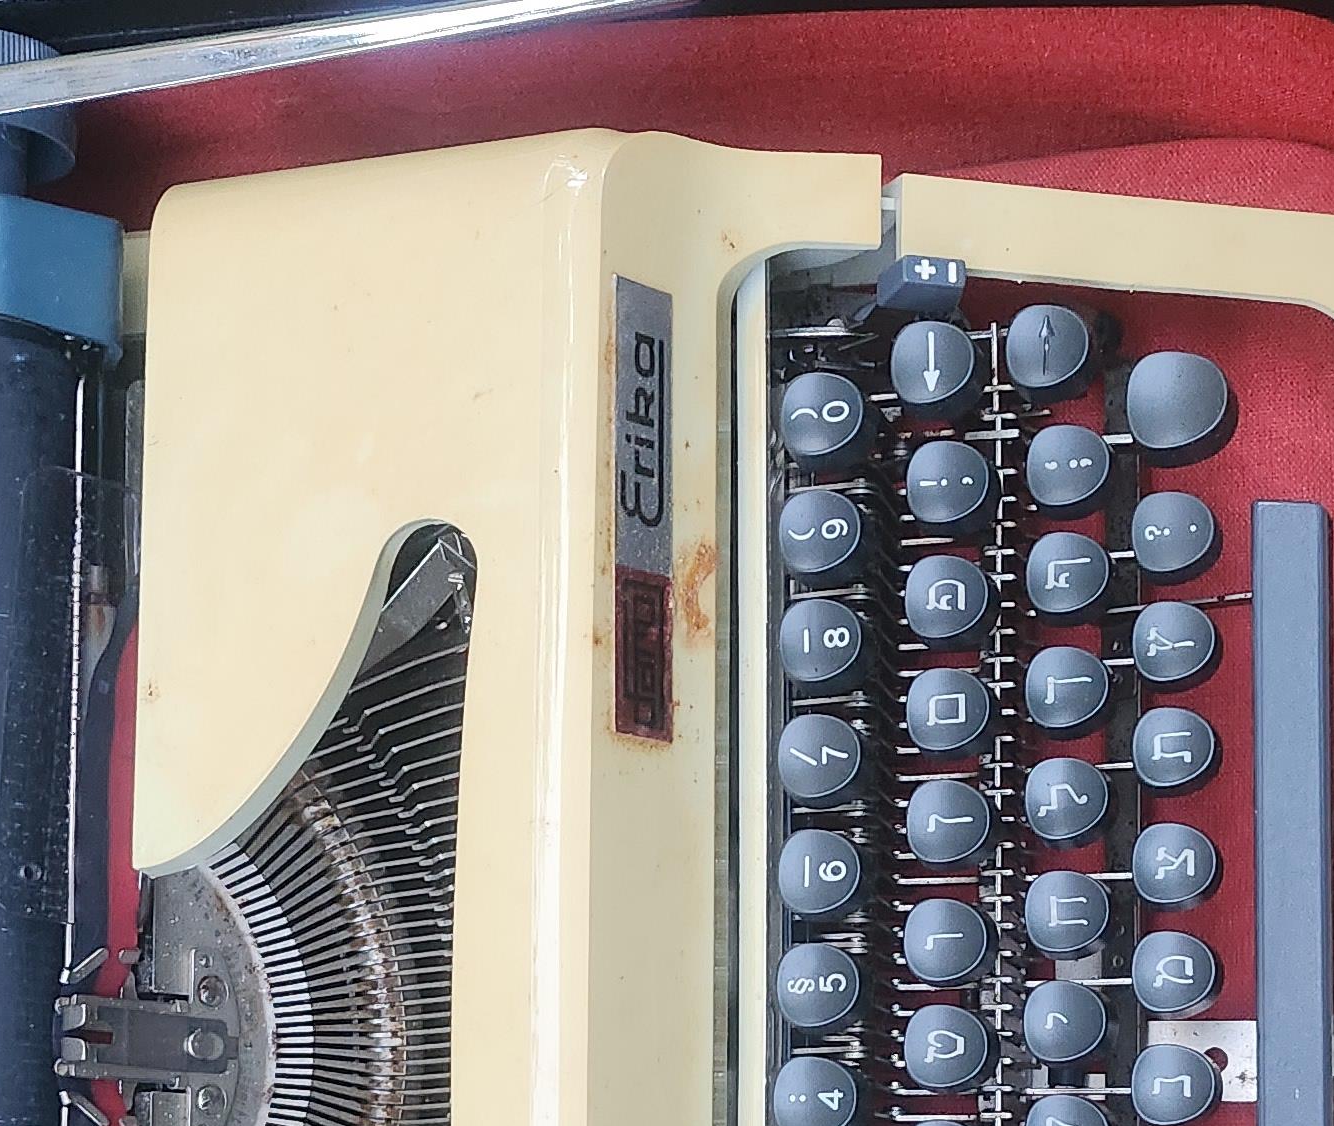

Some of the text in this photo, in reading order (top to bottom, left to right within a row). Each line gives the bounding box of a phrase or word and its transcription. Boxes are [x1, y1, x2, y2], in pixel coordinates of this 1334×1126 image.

[822, 400, 850, 423] 0
[619, 331, 665, 528] Erika
[821, 518, 849, 540] 9
[1144, 525, 1171, 541] ?
[1043, 556, 1091, 590] ף
[924, 578, 966, 611] פ
[822, 627, 850, 649] 8
[1146, 626, 1195, 657] ץ
[1043, 674, 1093, 705] ך
[925, 692, 966, 727] ם
[821, 745, 849, 765] 7
[1151, 731, 1192, 763] ת
[1036, 781, 1088, 817] ל
[819, 860, 847, 882] 6
[1154, 846, 1195, 880] צ
[1047, 893, 1089, 928] ח
[787, 978, 816, 995] §
[818, 973, 847, 993] 5
[1152, 955, 1194, 988] מ
[923, 1028, 965, 1064] ט
[818, 1088, 844, 1111] 4
[1151, 1074, 1192, 1098] נ
